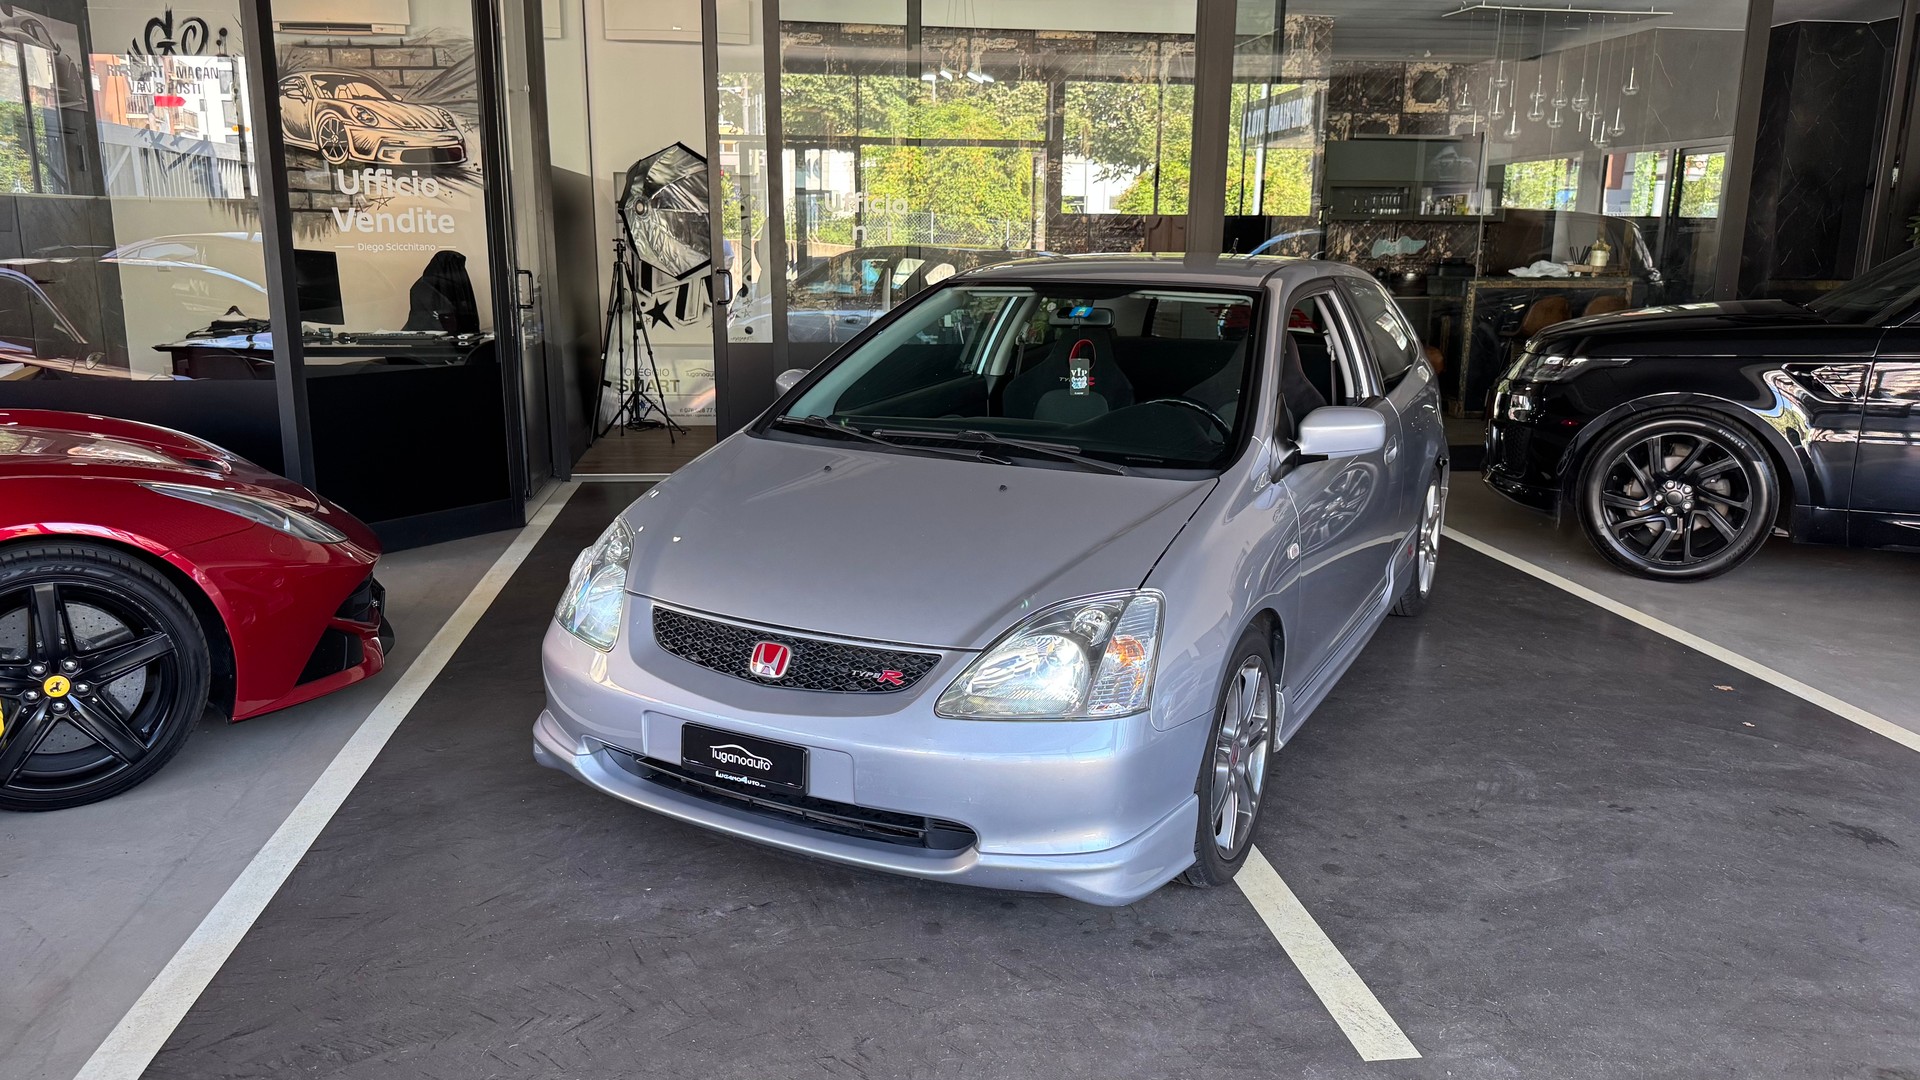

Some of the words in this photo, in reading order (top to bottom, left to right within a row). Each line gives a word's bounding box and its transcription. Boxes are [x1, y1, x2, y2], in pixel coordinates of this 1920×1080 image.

[175, 66, 219, 80] MACAN
[337, 167, 441, 198] Ufficio
[824, 191, 908, 214] Ufficio
[331, 206, 455, 234] Vendite
[357, 243, 384, 253] Diego
[385, 243, 436, 252] Scicchitano
[851, 669, 882, 679] TYPE
[877, 669, 905, 686] R
